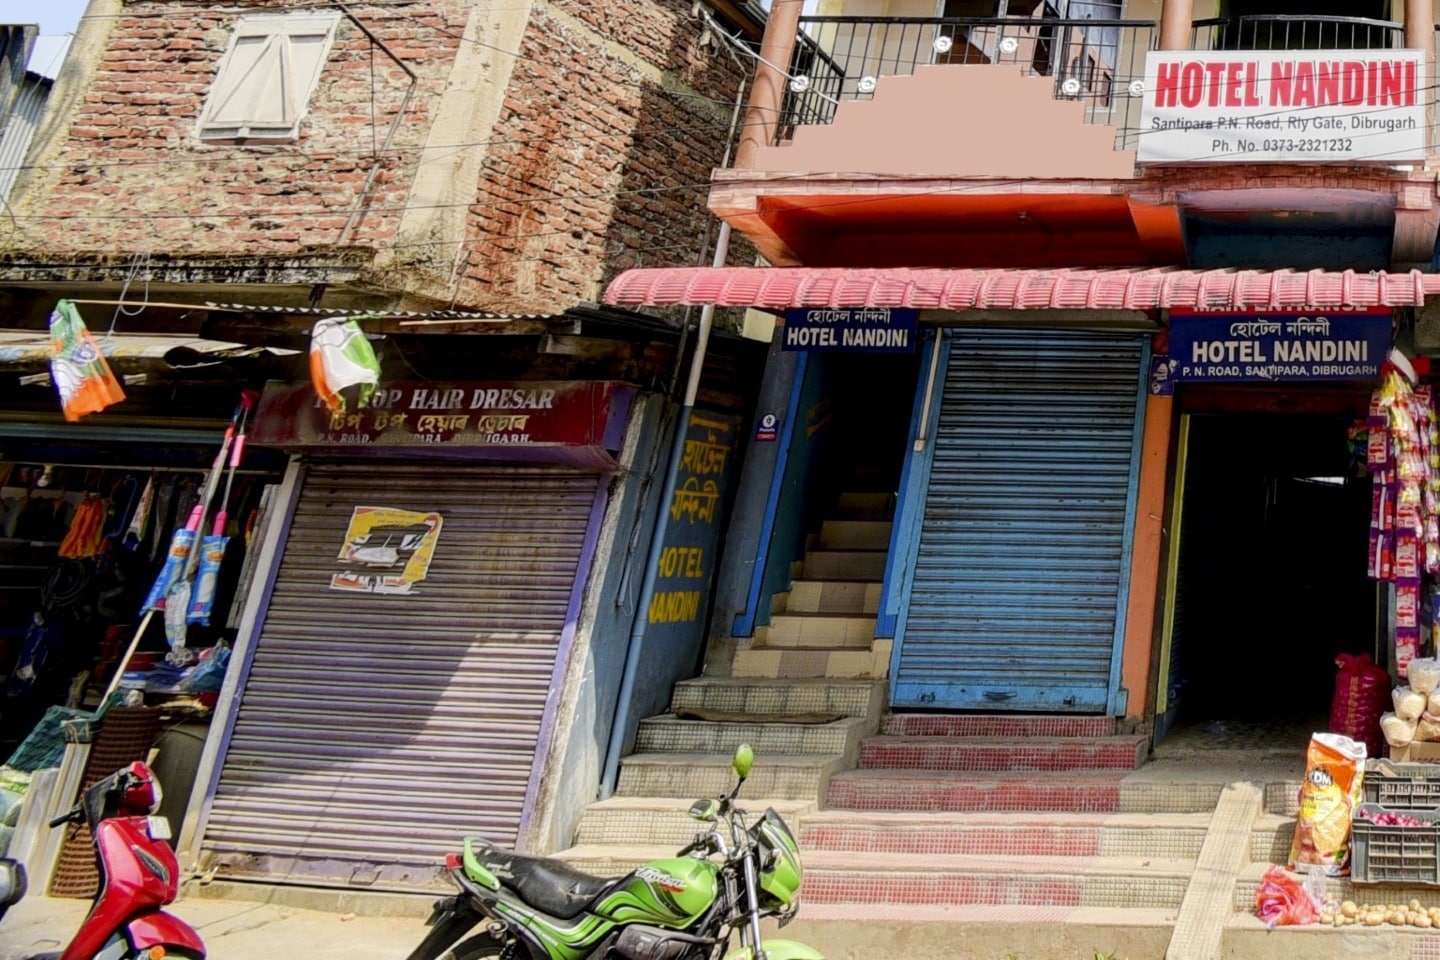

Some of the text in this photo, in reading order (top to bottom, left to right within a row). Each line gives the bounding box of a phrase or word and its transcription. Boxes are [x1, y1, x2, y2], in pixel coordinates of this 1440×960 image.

[1154, 59, 1417, 108] HOTEL NANDINI
[1151, 116, 1416, 133] Santipara P.N. Road, Rly Gate, Dibrugarh
[1212, 139, 1352, 152] Ph. No. 0373-2321232
[807, 308, 850, 323] হোটেল
[787, 327, 908, 347] HOTEL NANDINI
[1230, 317, 1331, 337] হোটেল নন্দিনী
[1193, 340, 1367, 363] HOTEL NANDINI
[1182, 366, 1377, 377] P. N. ROAD, SANTIPARA, DIBRUGARH
[409, 389, 463, 409] HAIR
[469, 389, 554, 409] DRESAR
